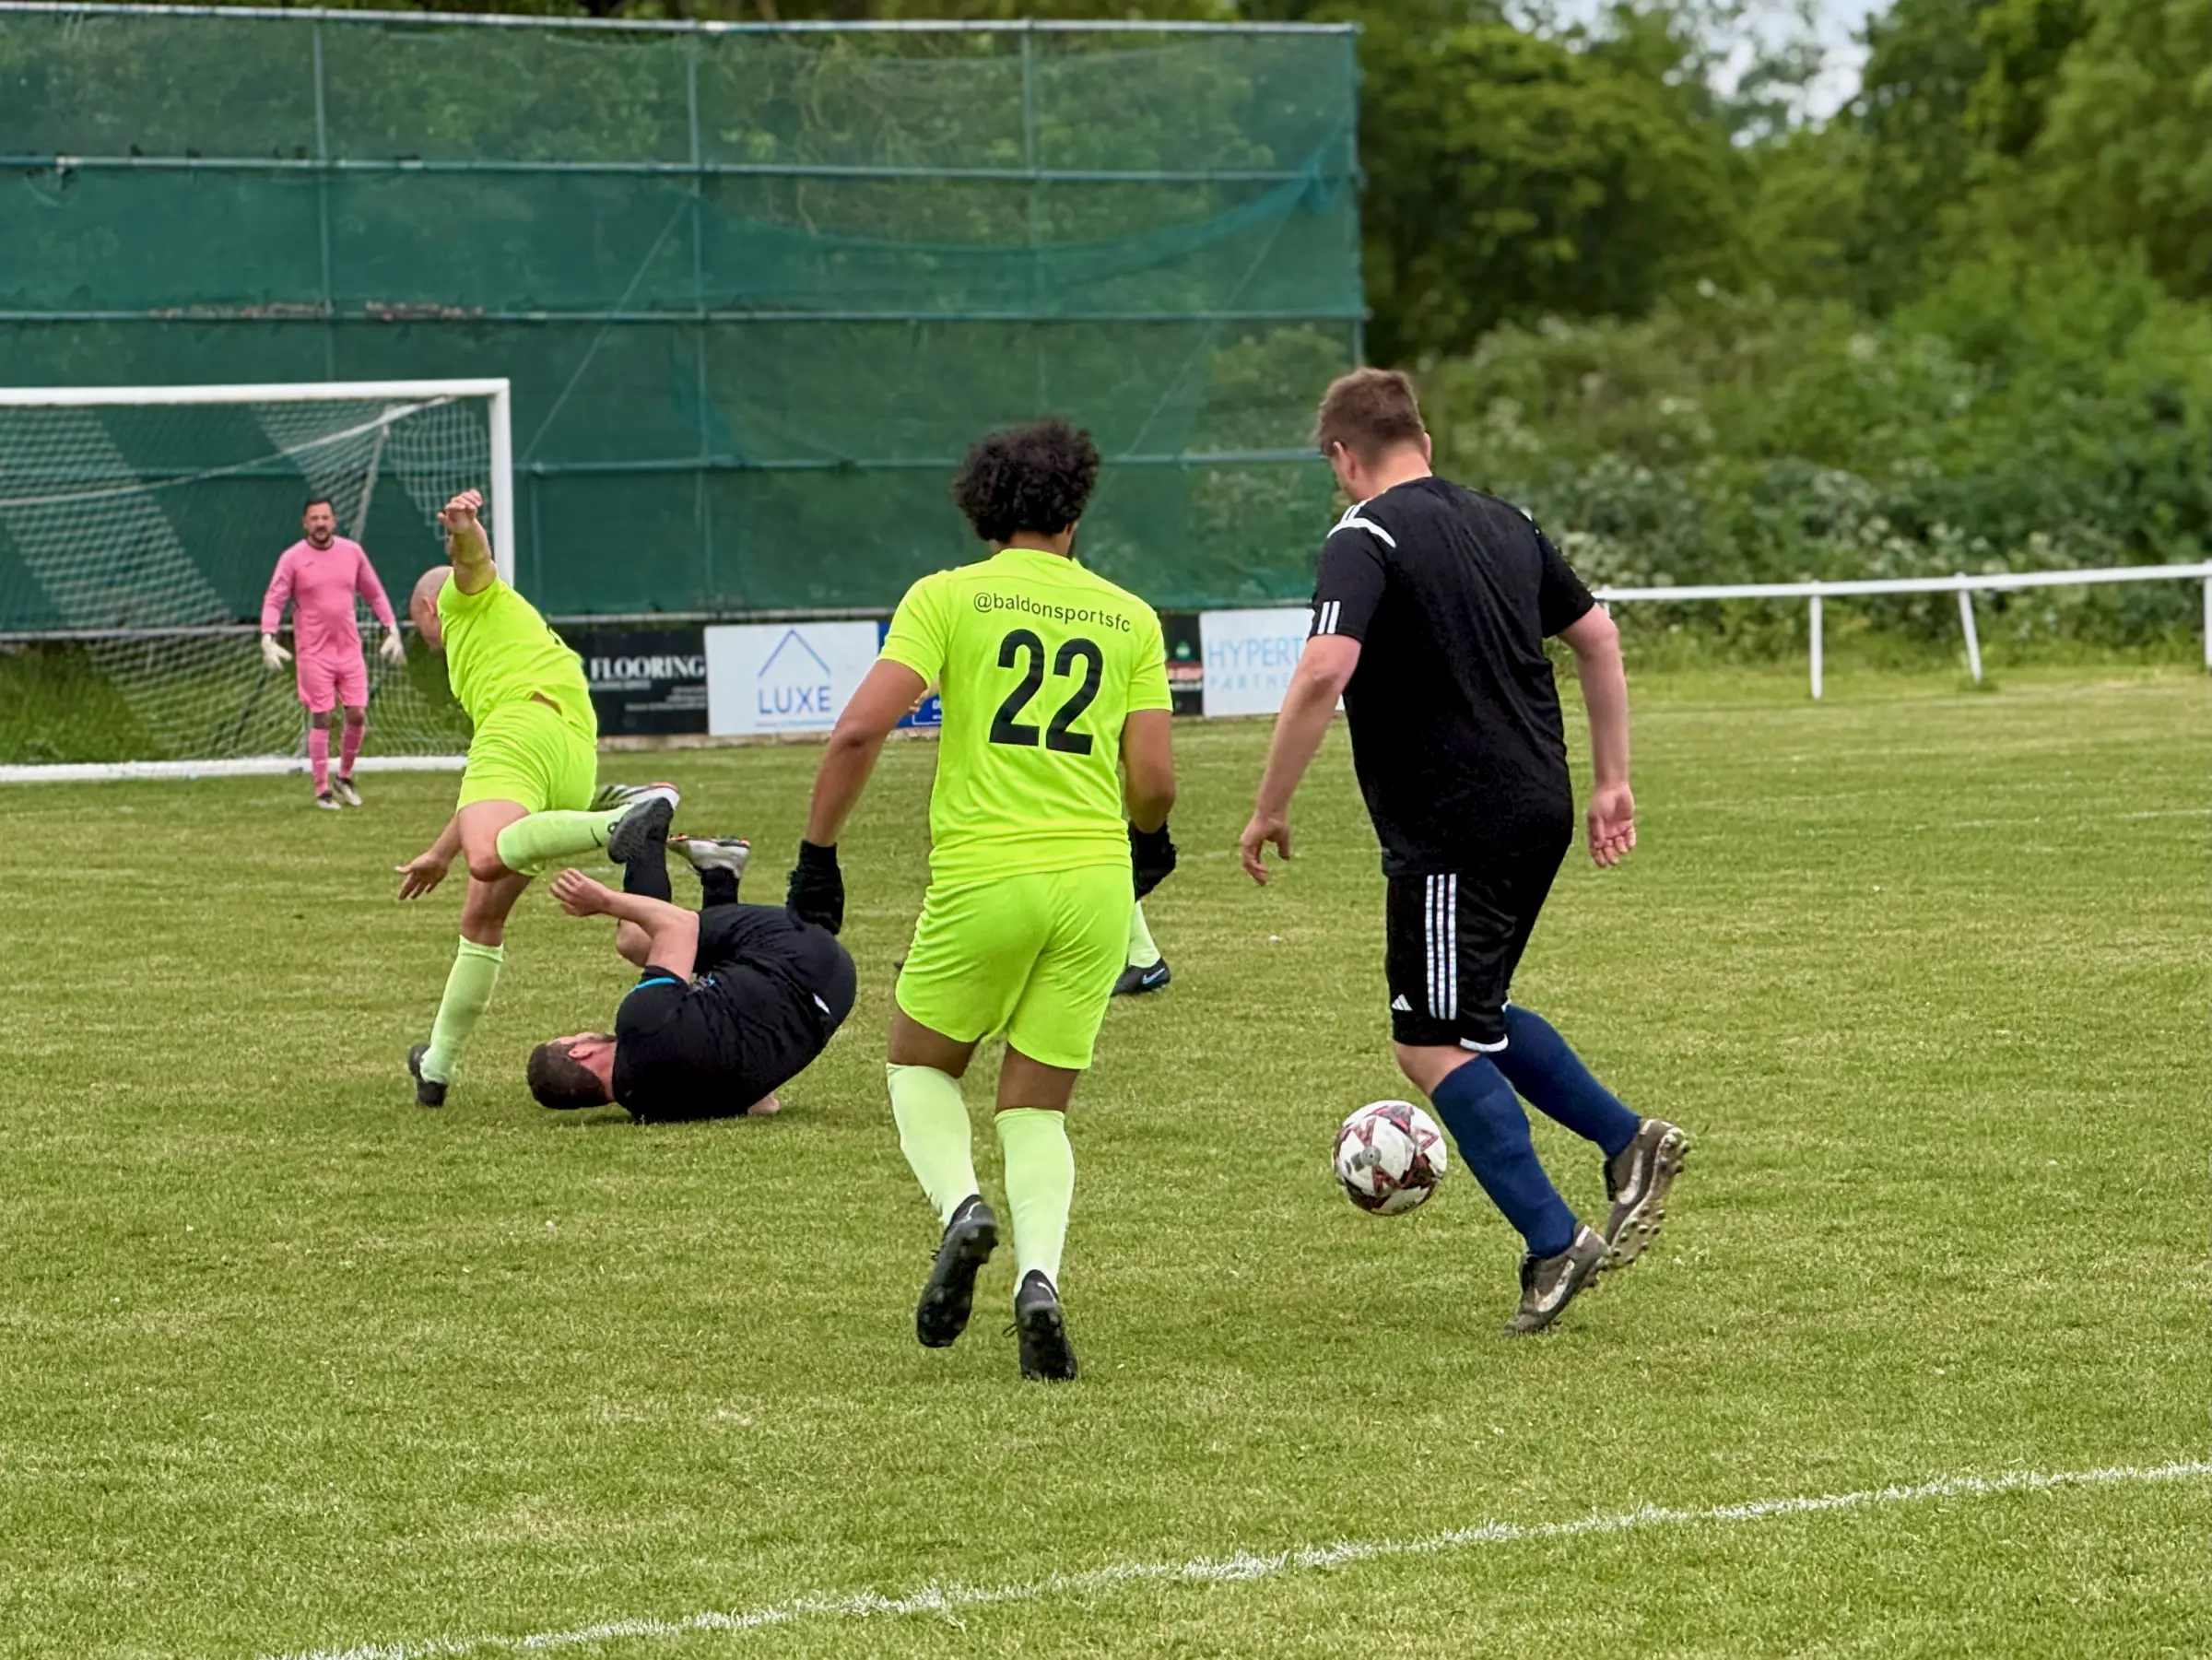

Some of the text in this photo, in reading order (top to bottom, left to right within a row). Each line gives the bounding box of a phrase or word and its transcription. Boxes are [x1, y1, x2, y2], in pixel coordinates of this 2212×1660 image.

[973, 592, 1131, 633] @baldonsportsfc
[590, 654, 706, 680] FLOORING
[758, 685, 832, 714] LUXE
[989, 629, 1103, 756] 22
